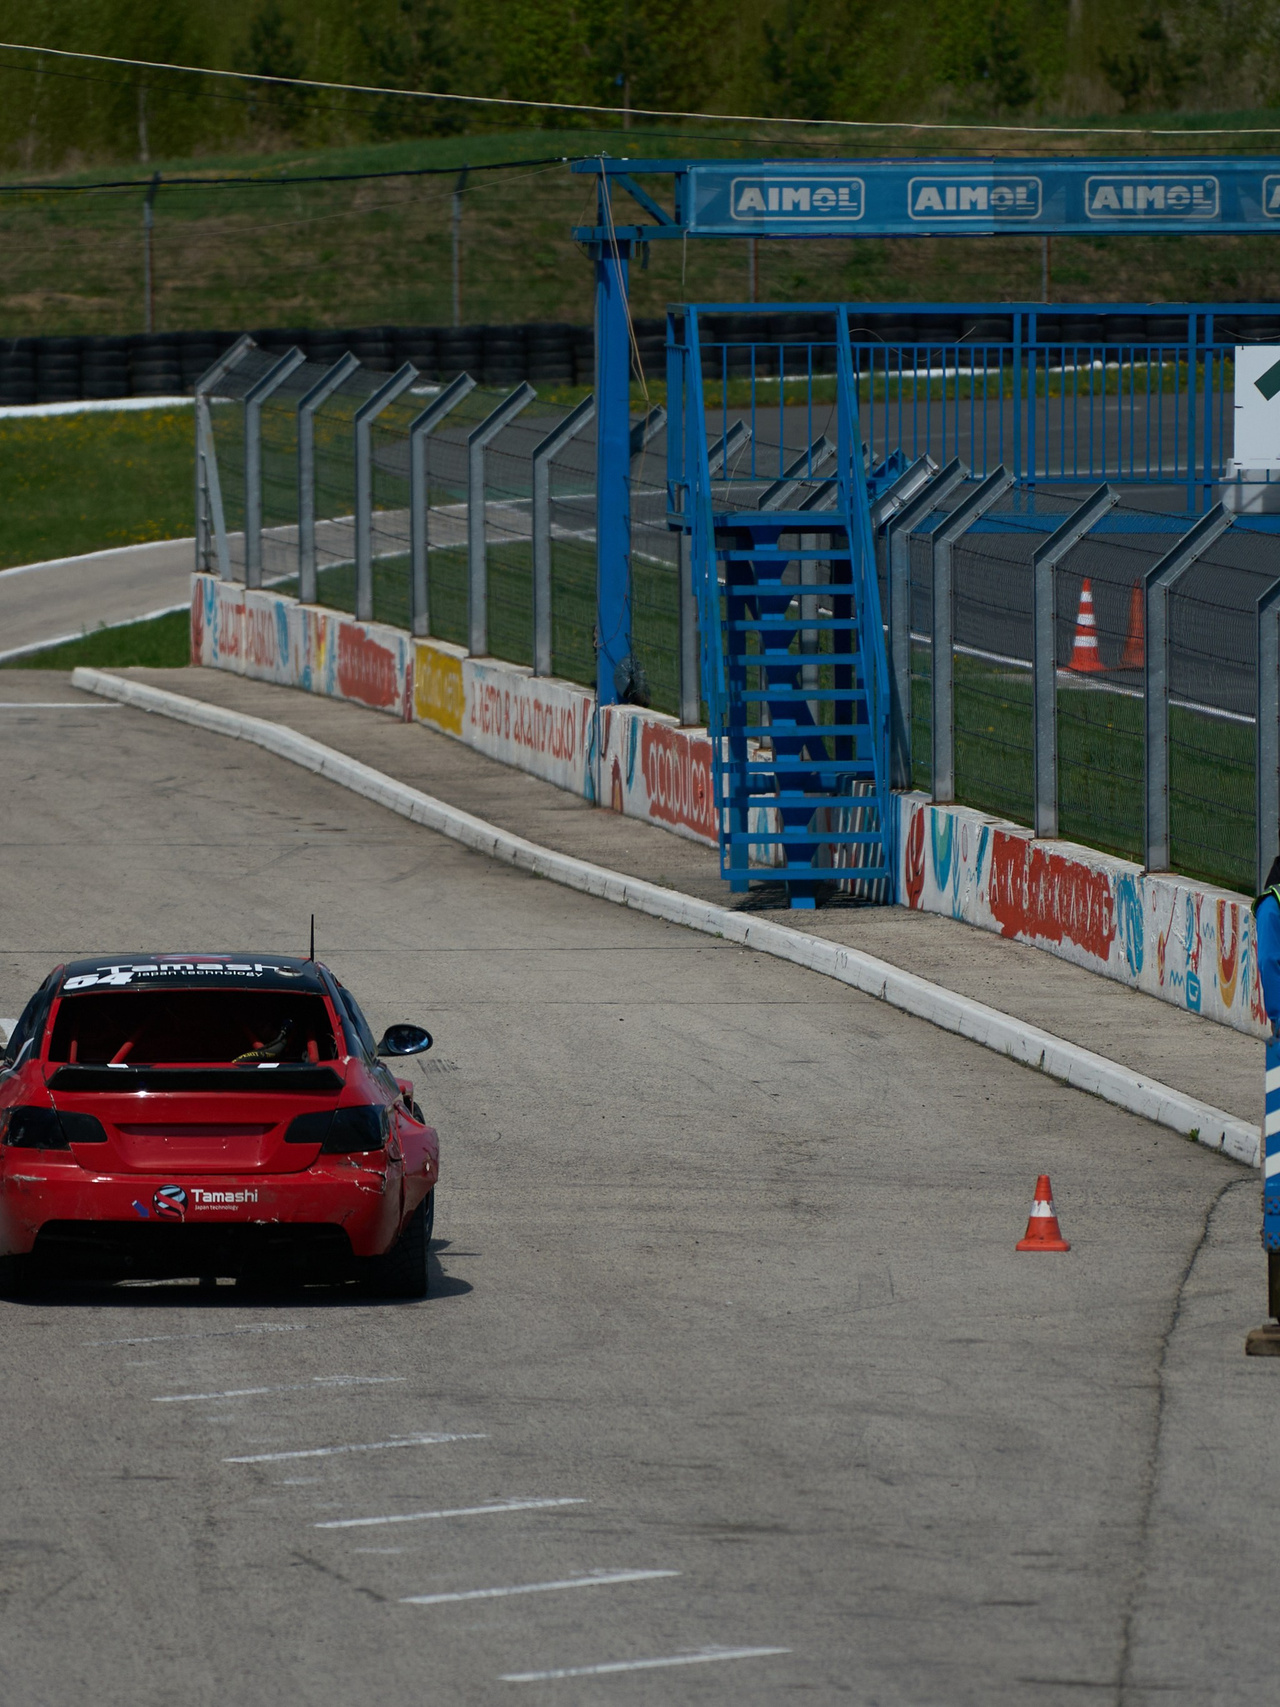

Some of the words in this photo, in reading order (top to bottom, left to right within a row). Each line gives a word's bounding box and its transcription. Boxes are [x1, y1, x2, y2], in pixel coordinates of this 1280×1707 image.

[97, 963, 291, 975] Tamash
[63, 972, 134, 990] 54
[190, 1189, 259, 1203] Tamashi
[209, 1204, 239, 1212] technology
